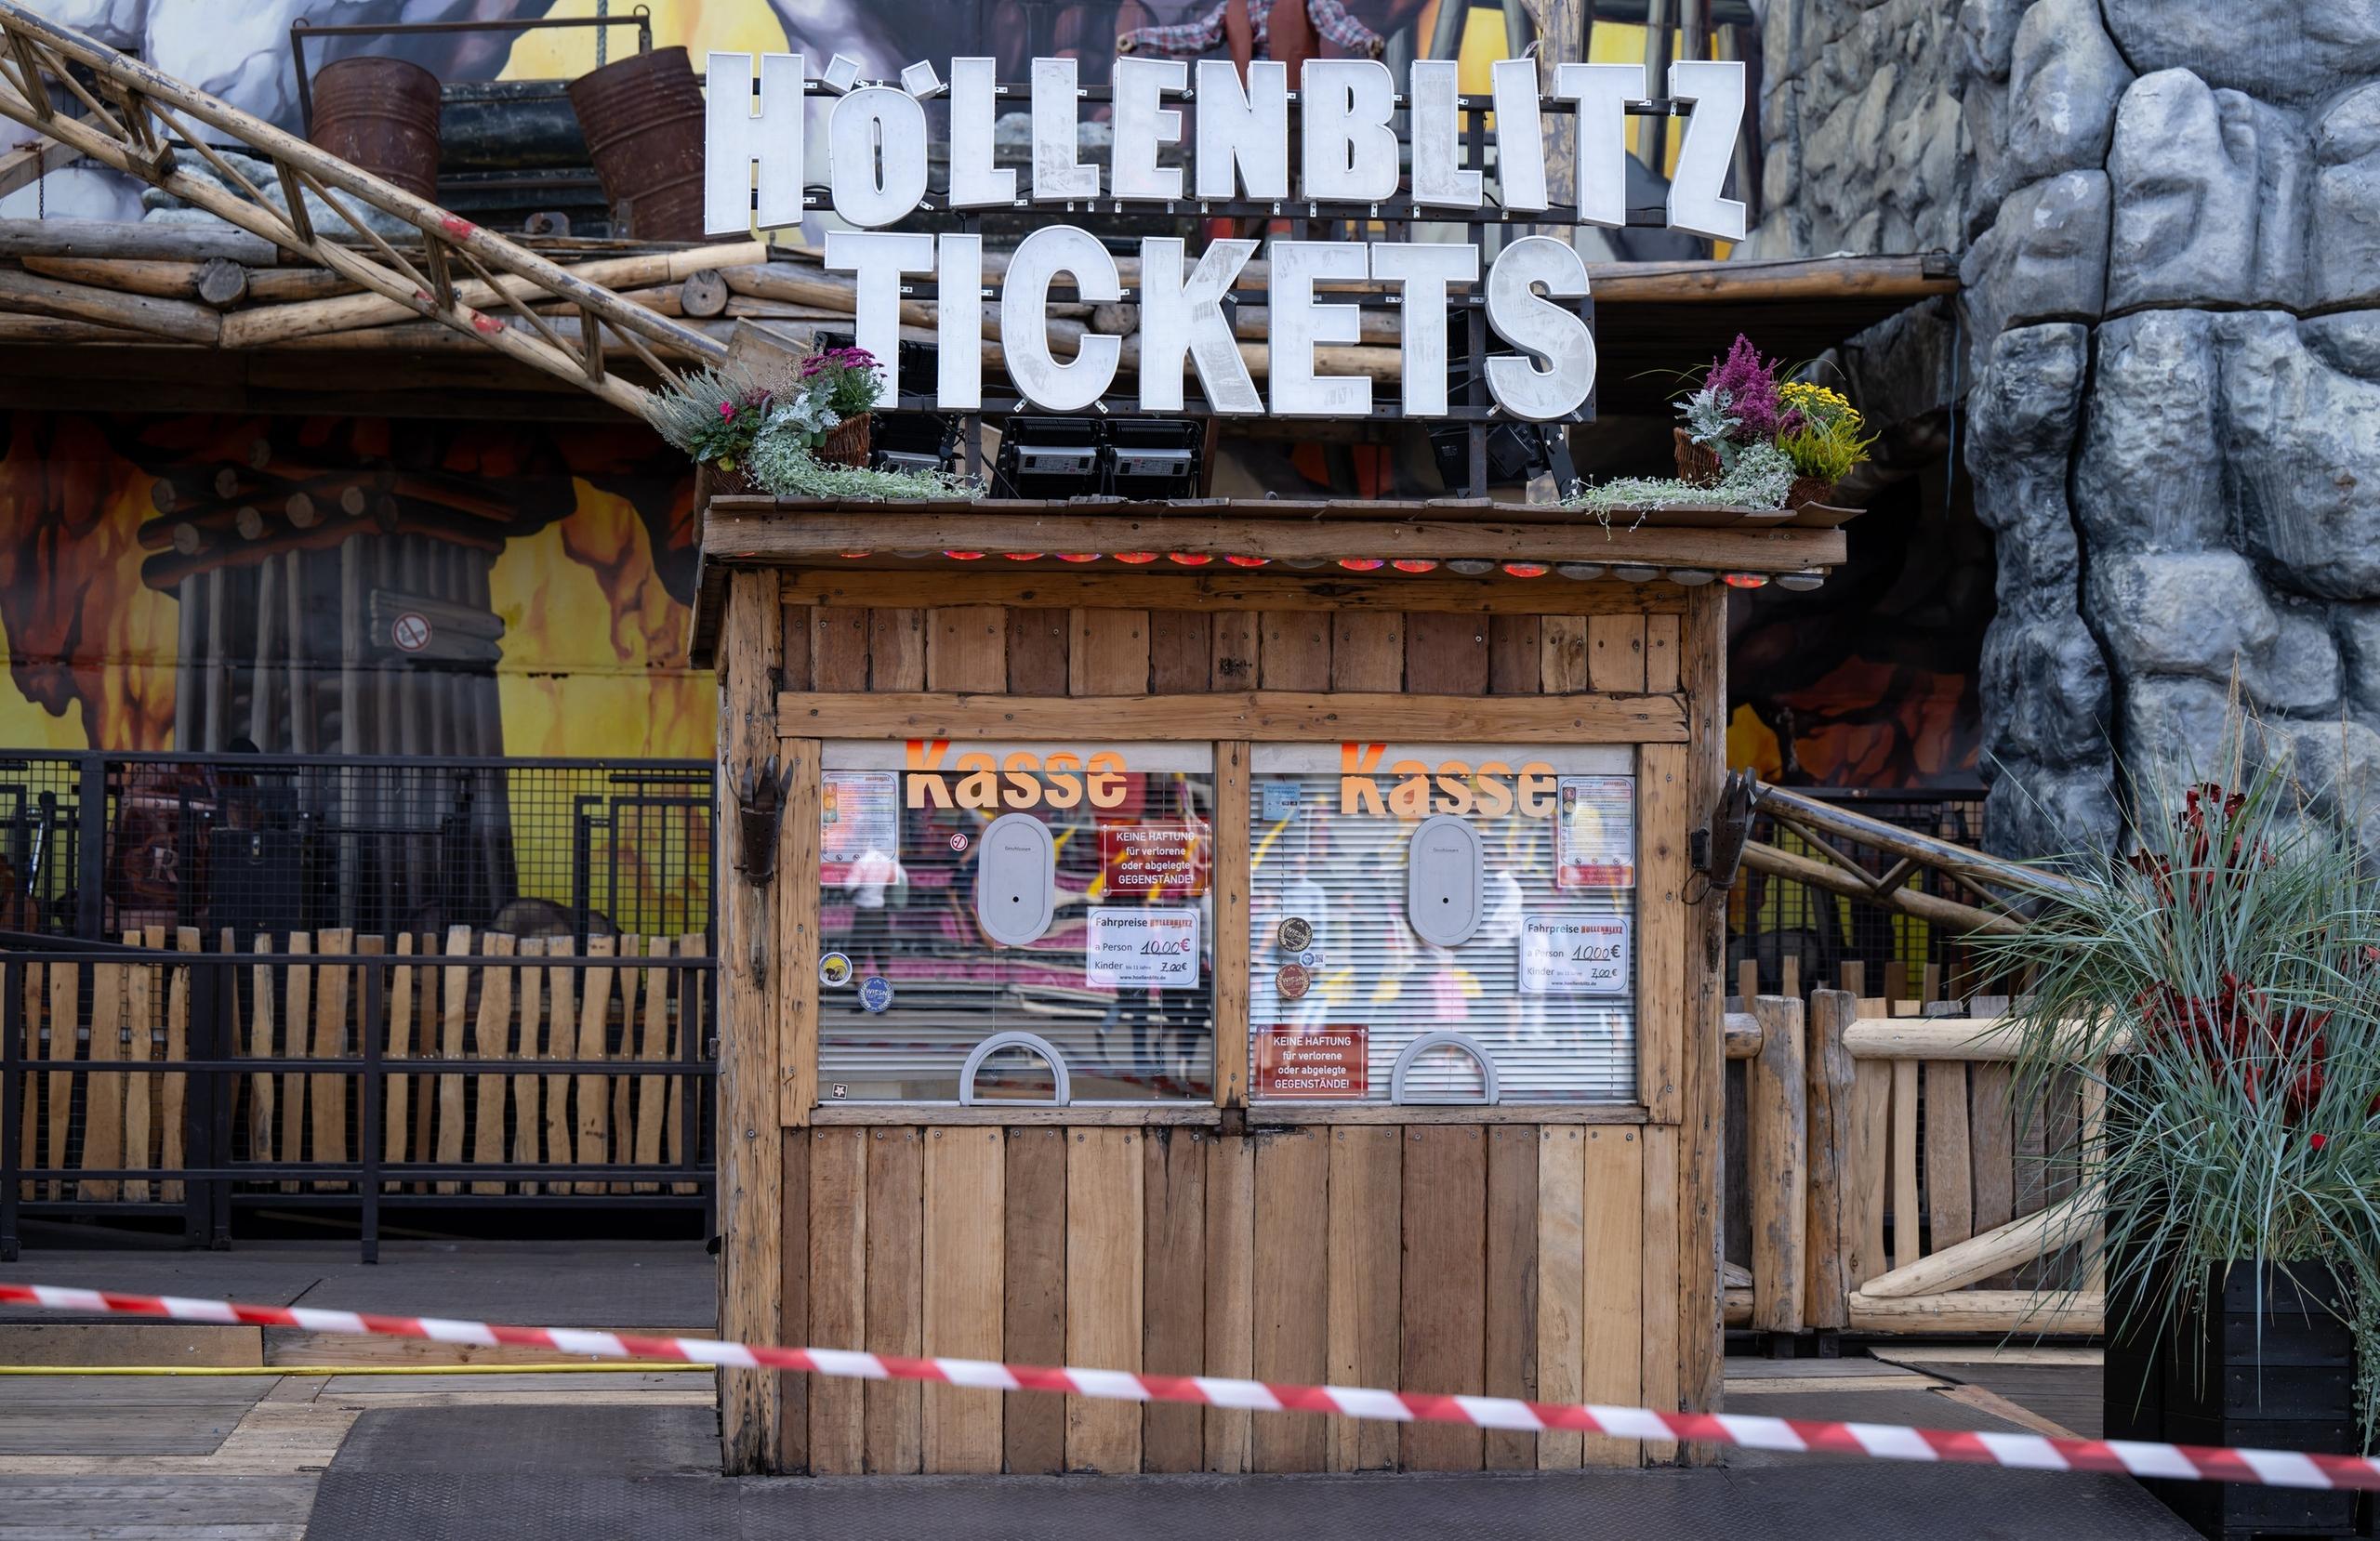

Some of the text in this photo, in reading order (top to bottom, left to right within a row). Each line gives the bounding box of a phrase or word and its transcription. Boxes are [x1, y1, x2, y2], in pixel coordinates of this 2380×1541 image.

[705, 50, 1745, 242] HÖLLENBLITZ
[825, 224, 1595, 423] TICKETS
[906, 739, 1128, 809] Kasse
[1341, 741, 1558, 818] Kasse
[1116, 832, 1196, 841] KEINE HAFTUNG
[1126, 847, 1186, 855] für verlorene
[1121, 861, 1191, 871] oder abgelegte
[1118, 873, 1195, 884] GEGENSTÄNDE!
[1095, 917, 1148, 929] Fahrpreise
[1527, 924, 1580, 935] Fahrpreise
[1103, 942, 1132, 952] Person
[1094, 961, 1123, 969] Kinder
[1273, 1036, 1352, 1046] KEINE HAFTUNG
[1283, 1051, 1342, 1060] für verlorene
[1278, 1065, 1346, 1076] oder abgelegte
[1275, 1078, 1350, 1088] GEGENSTÄNDE!
